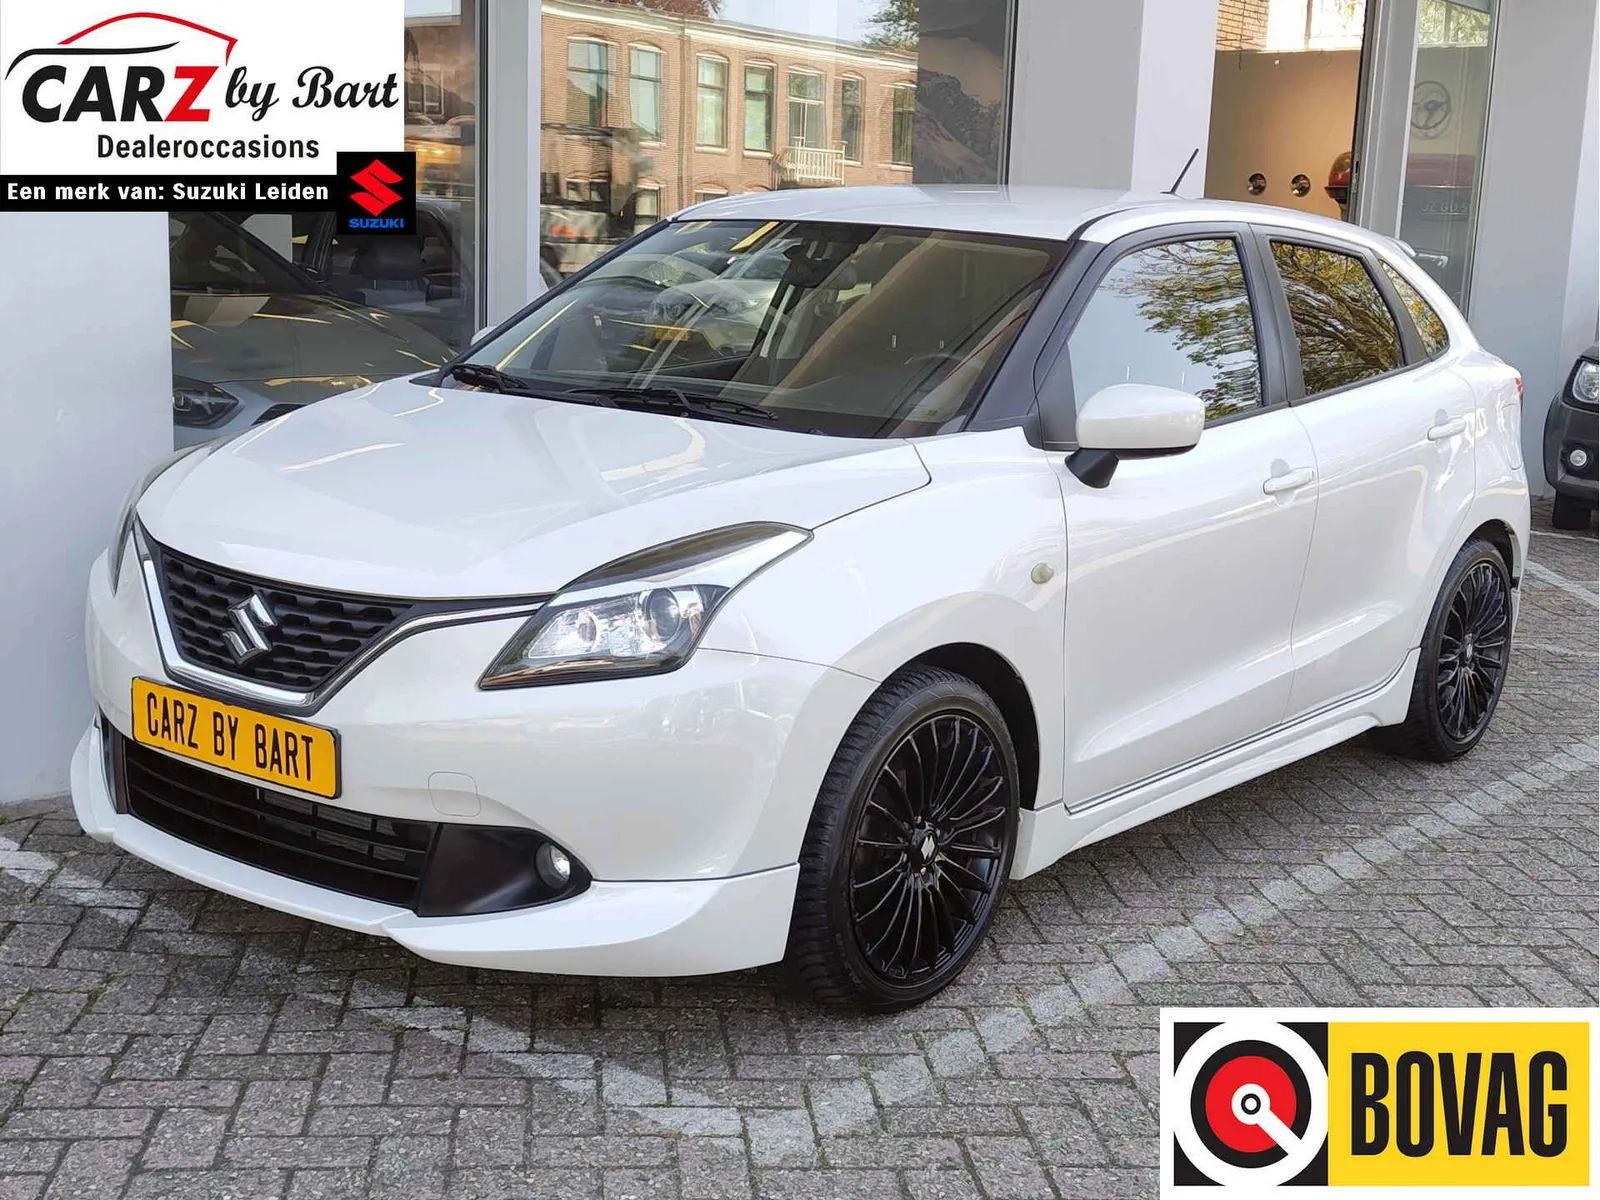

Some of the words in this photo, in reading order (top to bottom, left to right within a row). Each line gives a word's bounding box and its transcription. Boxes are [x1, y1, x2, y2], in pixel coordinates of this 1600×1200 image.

[147, 691, 198, 749] CARZ
[213, 711, 239, 761] BY
[254, 723, 313, 781] BART
